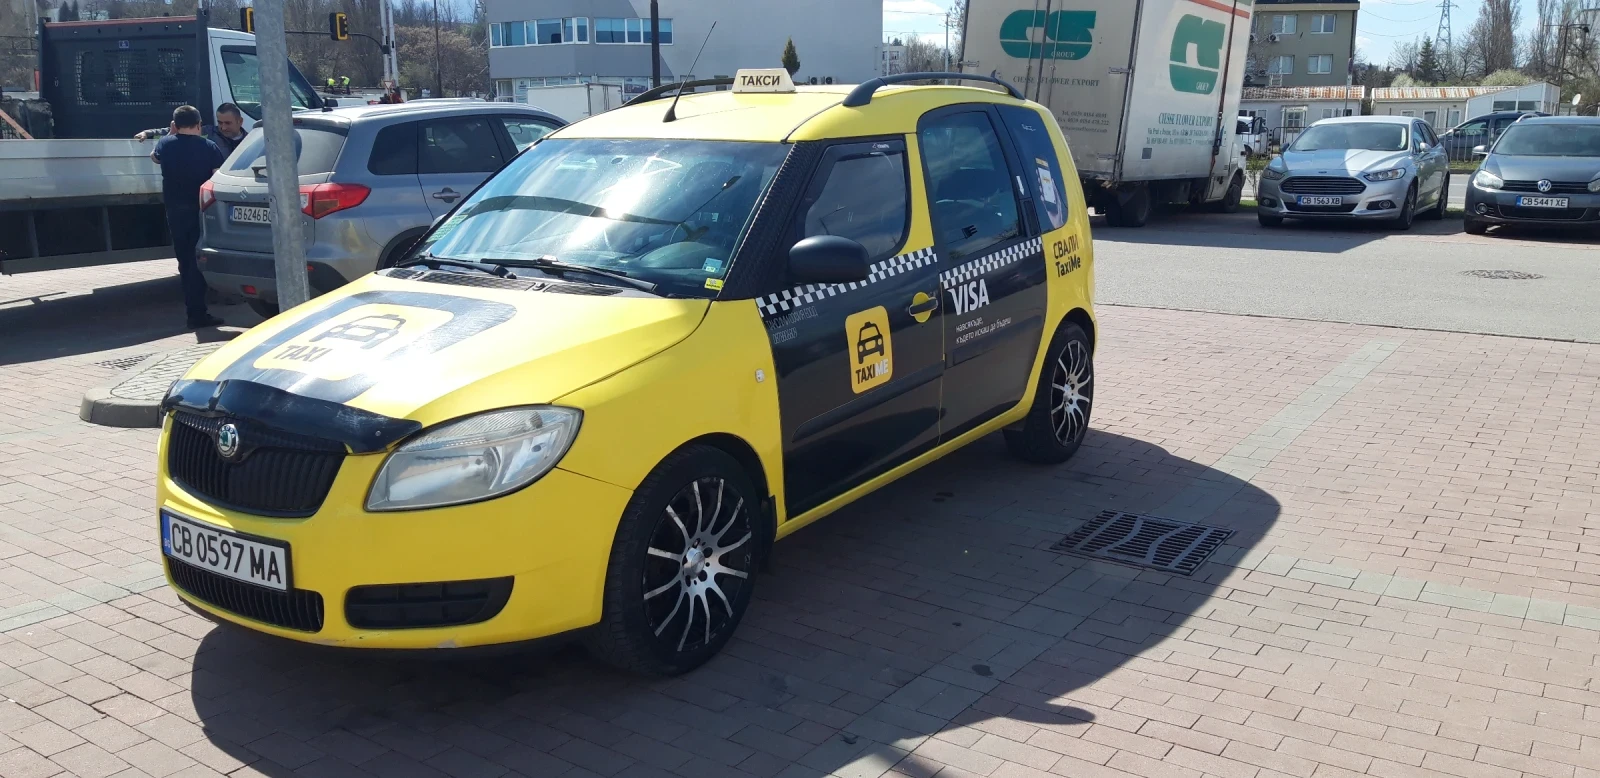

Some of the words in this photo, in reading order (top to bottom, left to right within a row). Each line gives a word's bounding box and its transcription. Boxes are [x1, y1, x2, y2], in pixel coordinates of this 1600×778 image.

[741, 75, 780, 86] ТАКСИ
[1071, 78, 1100, 87] EXPORT
[1313, 197, 1330, 205] 1563
[1533, 198, 1553, 206] 5441
[243, 208, 261, 222] 6246
[1053, 234, 1080, 260] СВАЛИ
[1055, 254, 1081, 278] TaxiMe
[947, 278, 990, 316] VISA
[956, 316, 984, 333] навсякъде,
[956, 332, 975, 345] където
[974, 326, 990, 338] искаш
[989, 323, 996, 334] да
[996, 316, 1012, 330] бъдеш
[273, 344, 333, 363] TAXI
[196, 531, 245, 574] 0597
